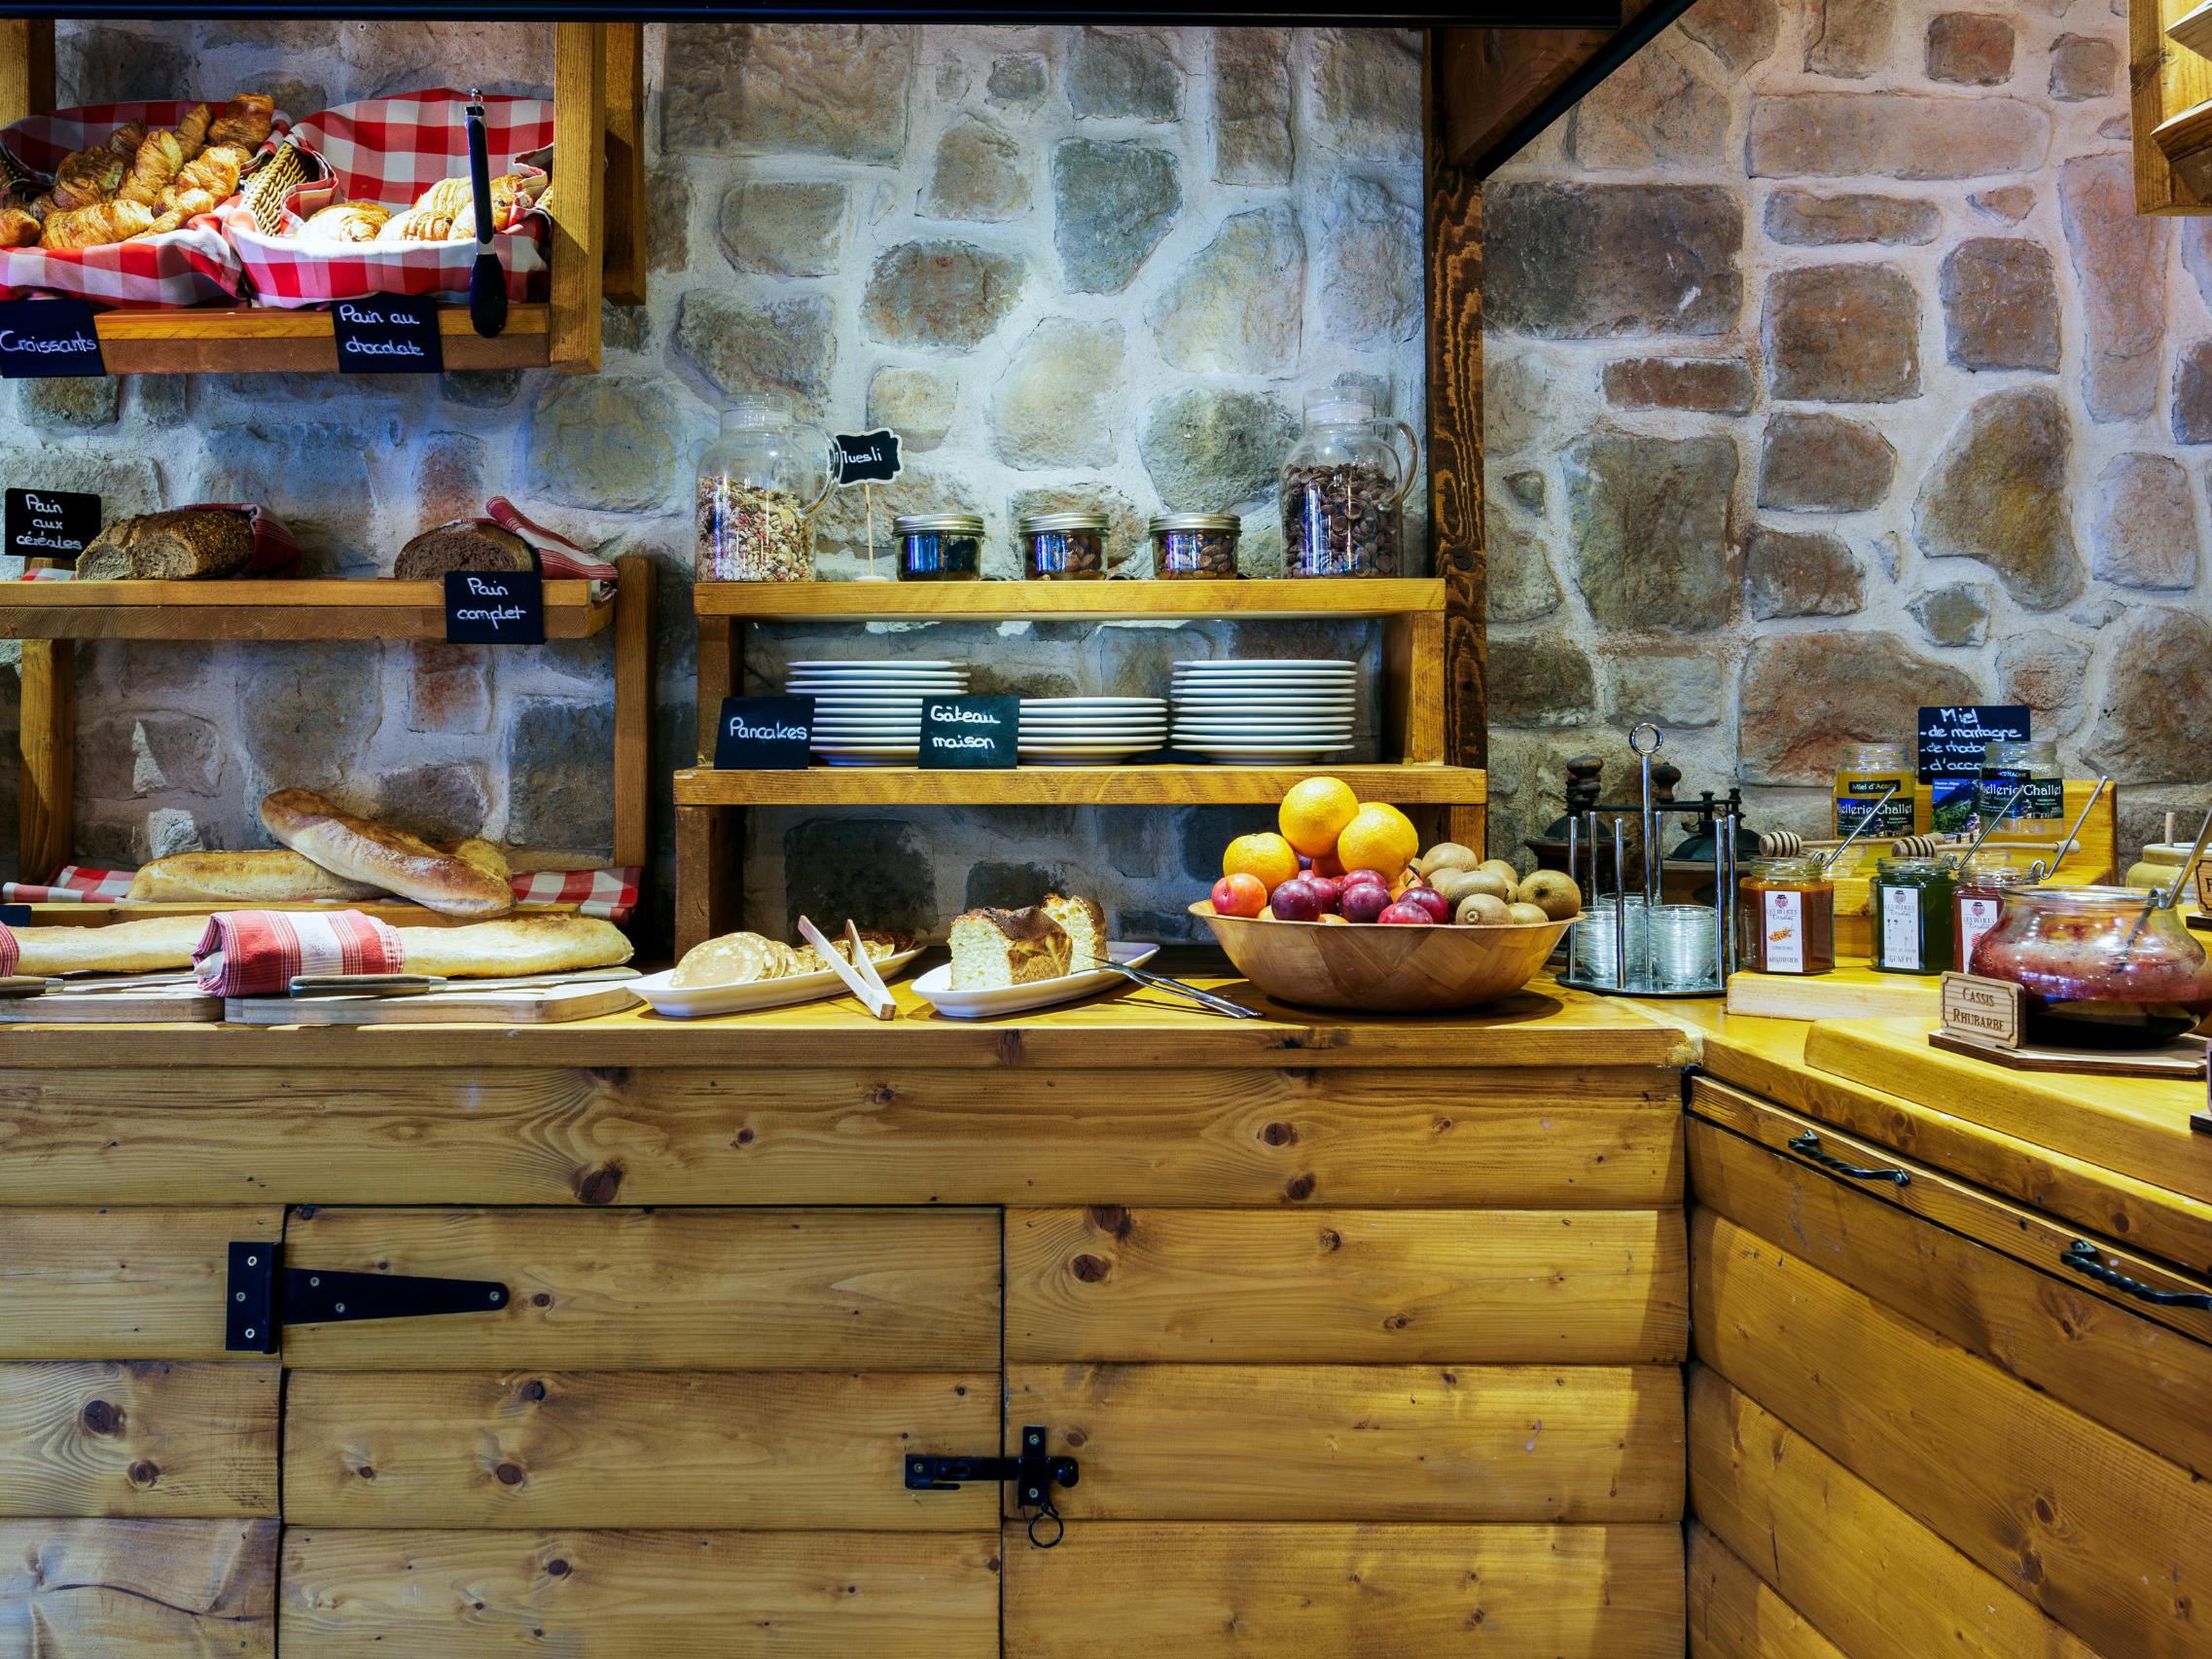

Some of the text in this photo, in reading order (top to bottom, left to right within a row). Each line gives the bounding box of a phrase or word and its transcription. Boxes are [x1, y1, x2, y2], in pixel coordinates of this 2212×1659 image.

[339, 304, 420, 324] Pain au
[0, 330, 97, 353] Croissants
[345, 336, 425, 356] chocolat
[25, 493, 63, 514] Pain
[32, 519, 63, 530] aux
[16, 530, 83, 550] céréales
[467, 577, 509, 595] Pain
[457, 604, 527, 630] complet
[1940, 707, 1979, 724] Miel
[730, 716, 807, 739] Pancakes
[932, 735, 996, 749] maison
[2023, 783, 2061, 796] Challet
[1962, 987, 1995, 1007] CASSIS
[1952, 1008, 2006, 1031] RHUBARBE
